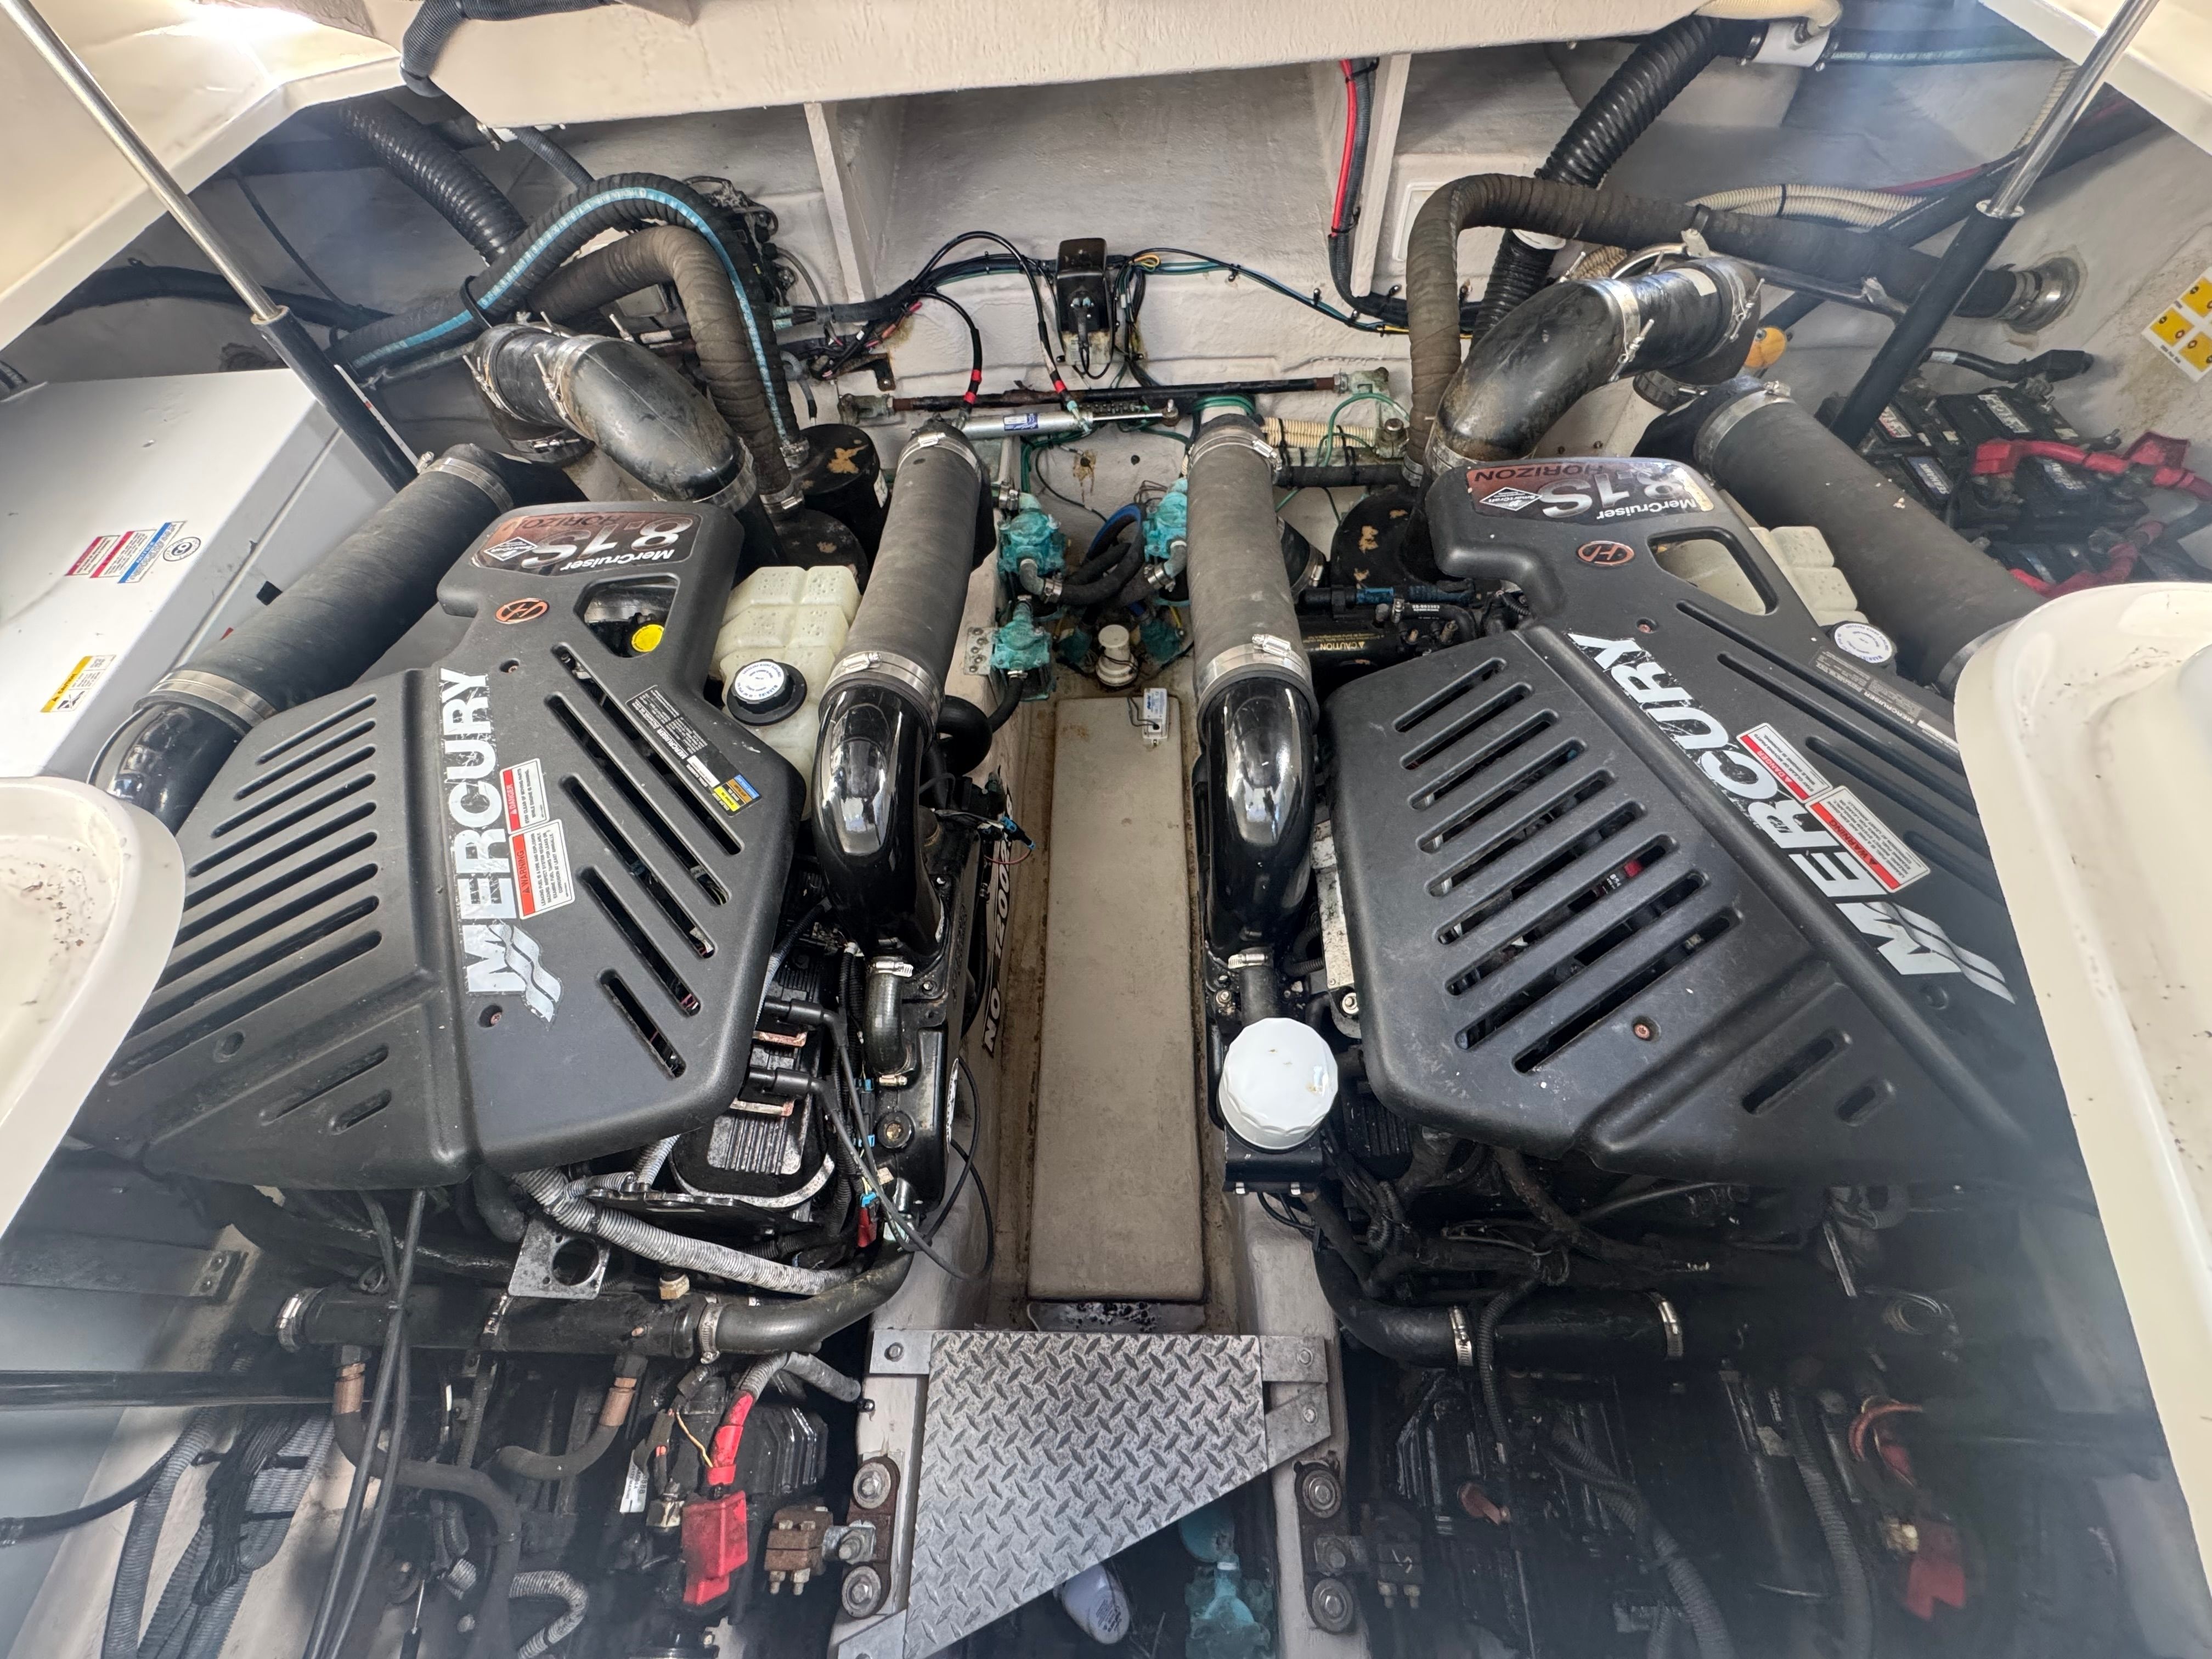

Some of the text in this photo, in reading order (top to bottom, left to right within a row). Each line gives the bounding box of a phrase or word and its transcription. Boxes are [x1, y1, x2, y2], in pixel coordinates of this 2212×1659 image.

[1474, 464, 1602, 481] HORIZON
[502, 514, 623, 531] HORIZON
[1595, 498, 1696, 520] MerCruiser
[522, 518, 692, 569] 8.1S
[559, 549, 674, 571] MerCruiser
[1863, 690, 1915, 723] MERCRUISER
[656, 727, 687, 759] MERCRUISER
[1756, 750, 1786, 777] DANGER
[506, 783, 516, 809] DANGER
[1567, 633, 1962, 975] MERCURY
[440, 668, 531, 994] MERCURY
[1828, 819, 1869, 858] WARNING
[516, 850, 528, 886] WARNING
